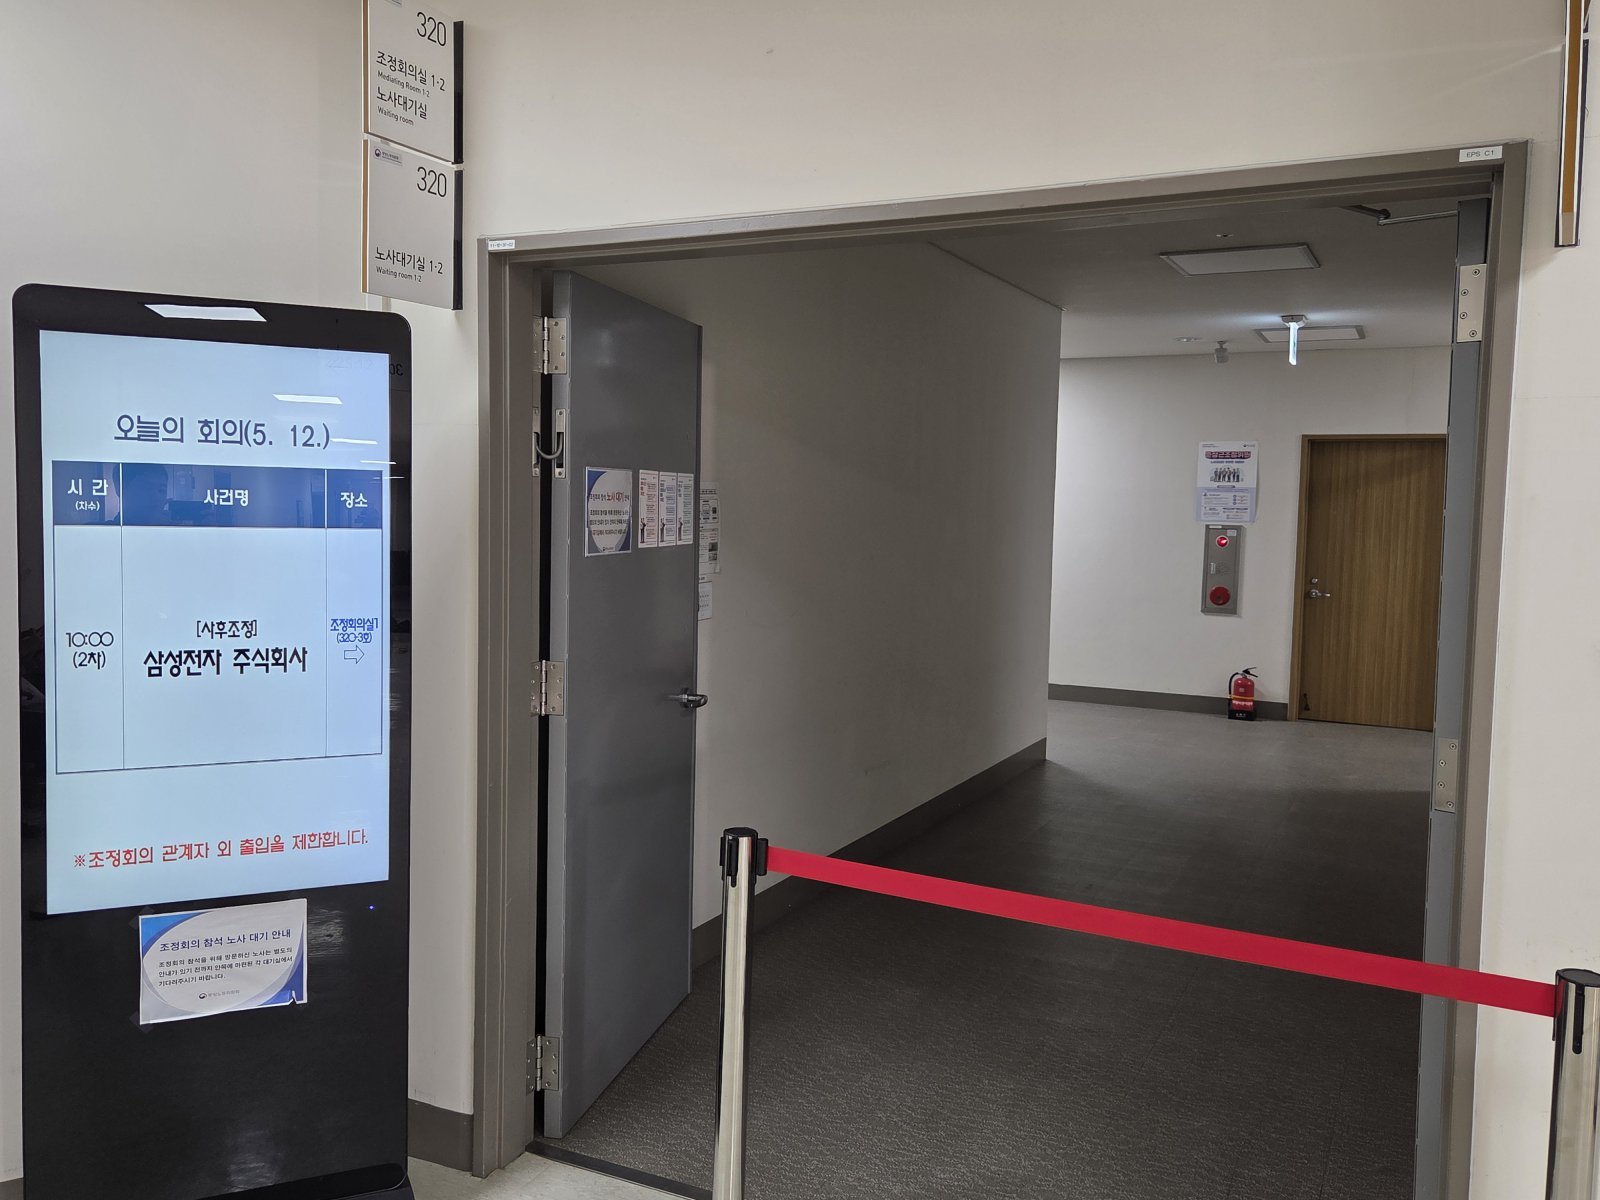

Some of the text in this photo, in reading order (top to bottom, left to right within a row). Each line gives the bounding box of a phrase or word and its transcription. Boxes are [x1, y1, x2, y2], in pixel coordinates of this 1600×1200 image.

[416, 11, 447, 47] 320
[376, 50, 427, 86] 조정회의실
[377, 70, 405, 89] Mediating
[405, 81, 421, 94] Room
[376, 86, 427, 120] 노사대기실
[377, 105, 414, 126] Waiting room
[416, 166, 447, 198] 320
[375, 246, 426, 273] 노사대기실
[376, 265, 398, 279] Waiting
[398, 271, 413, 281] room
[114, 414, 330, 450] 오늘의 회의(5. 12.)
[75, 500, 101, 512] (차수)
[203, 488, 249, 507] 사건명
[340, 491, 368, 508] 장소
[196, 619, 258, 639] [사후조정]
[330, 617, 379, 632] 조정회의실1
[65, 631, 114, 648] 10:00
[336, 632, 373, 644] (320-3호)
[72, 651, 106, 670] (2차)
[143, 646, 308, 678] 삼성전자 주식회사
[162, 841, 210, 862] 관계자
[217, 839, 232, 858] 외
[239, 834, 285, 857] 출입을
[292, 828, 369, 851] 제한합니다.
[159, 928, 291, 953] 조정회의 참석 노사 대기 안내
[158, 969, 178, 978] 안내가
[179, 967, 192, 976] 있기
[194, 965, 213, 974] 전까지
[263, 955, 293, 966] 대기실에서
[159, 946, 293, 968] 조정회의 참석을 위해 방문하신 노사는 별도의
[158, 972, 226, 987] 기다려주시기 바랍니다.
